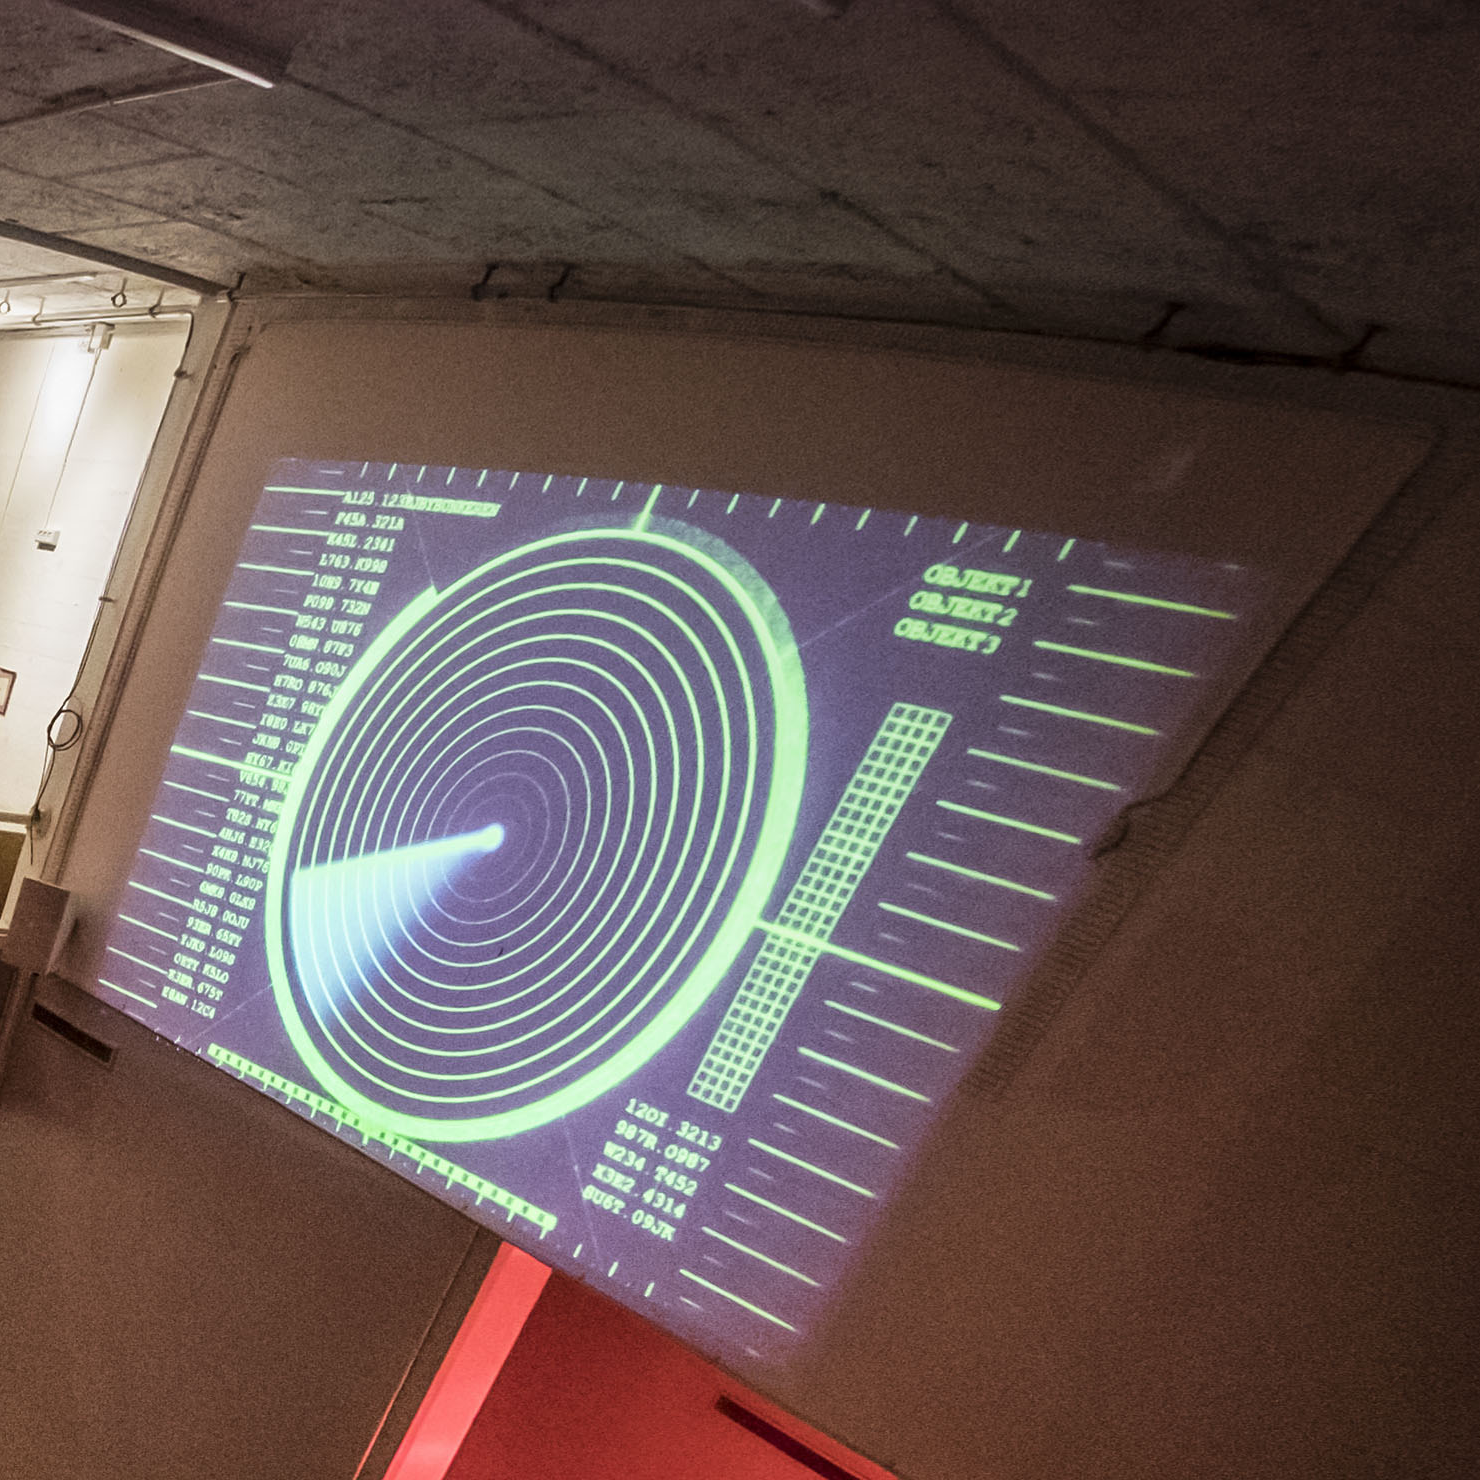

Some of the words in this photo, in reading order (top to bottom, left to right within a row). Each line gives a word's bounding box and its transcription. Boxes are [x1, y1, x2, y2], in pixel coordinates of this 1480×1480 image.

[922, 564, 1022, 596] OBJEKT
[1016, 579, 1033, 597] 1
[908, 590, 1005, 623] OBJEKT
[995, 607, 1019, 627] 2
[893, 617, 990, 651] OBJEKT
[981, 634, 1002, 655] 3
